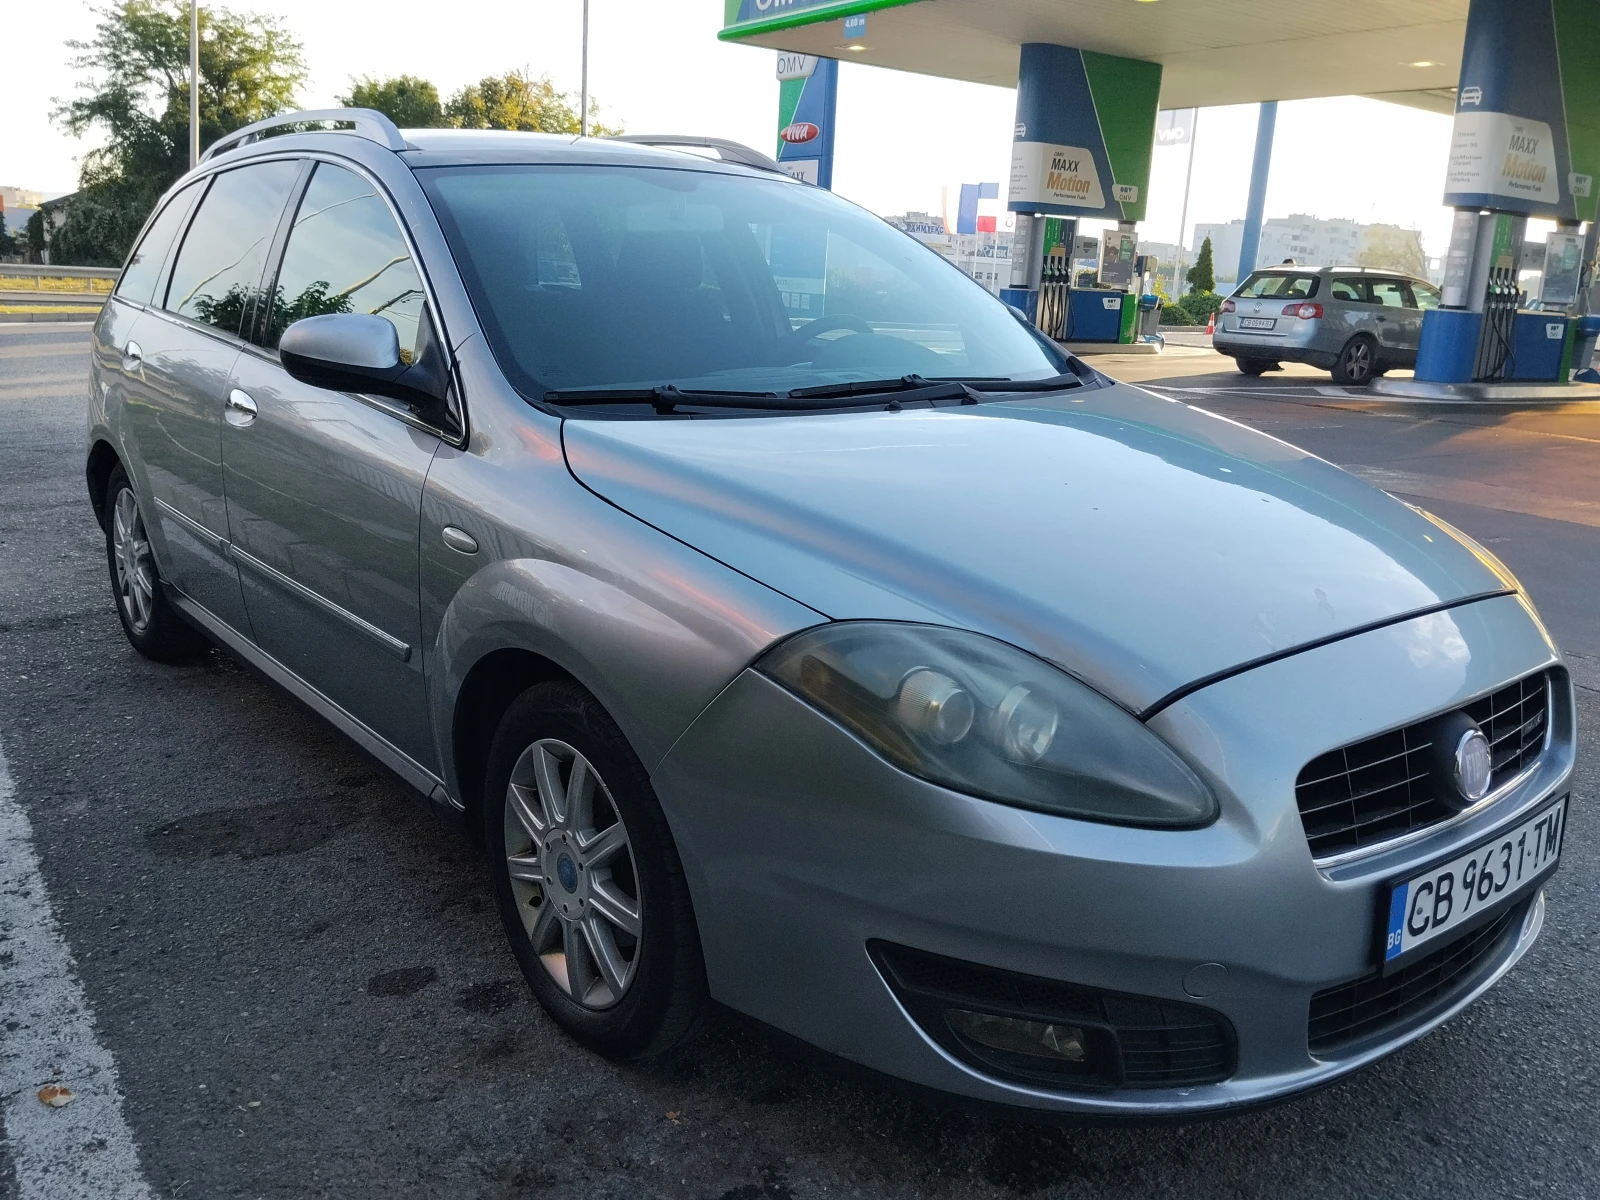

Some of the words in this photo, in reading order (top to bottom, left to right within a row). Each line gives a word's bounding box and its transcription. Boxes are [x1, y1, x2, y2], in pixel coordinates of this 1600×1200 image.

[777, 55, 807, 75] OMV
[1509, 134, 1539, 155] MAXX
[1051, 158, 1080, 172] MAXX
[1502, 153, 1547, 183] Motion
[791, 171, 805, 181] AXX
[1046, 171, 1091, 194] Motion
[1053, 192, 1076, 200] Performance
[1407, 871, 1455, 938] CB
[1462, 829, 1528, 914] 9631
[1533, 806, 1562, 870] TM
[1387, 929, 1402, 950] BG
